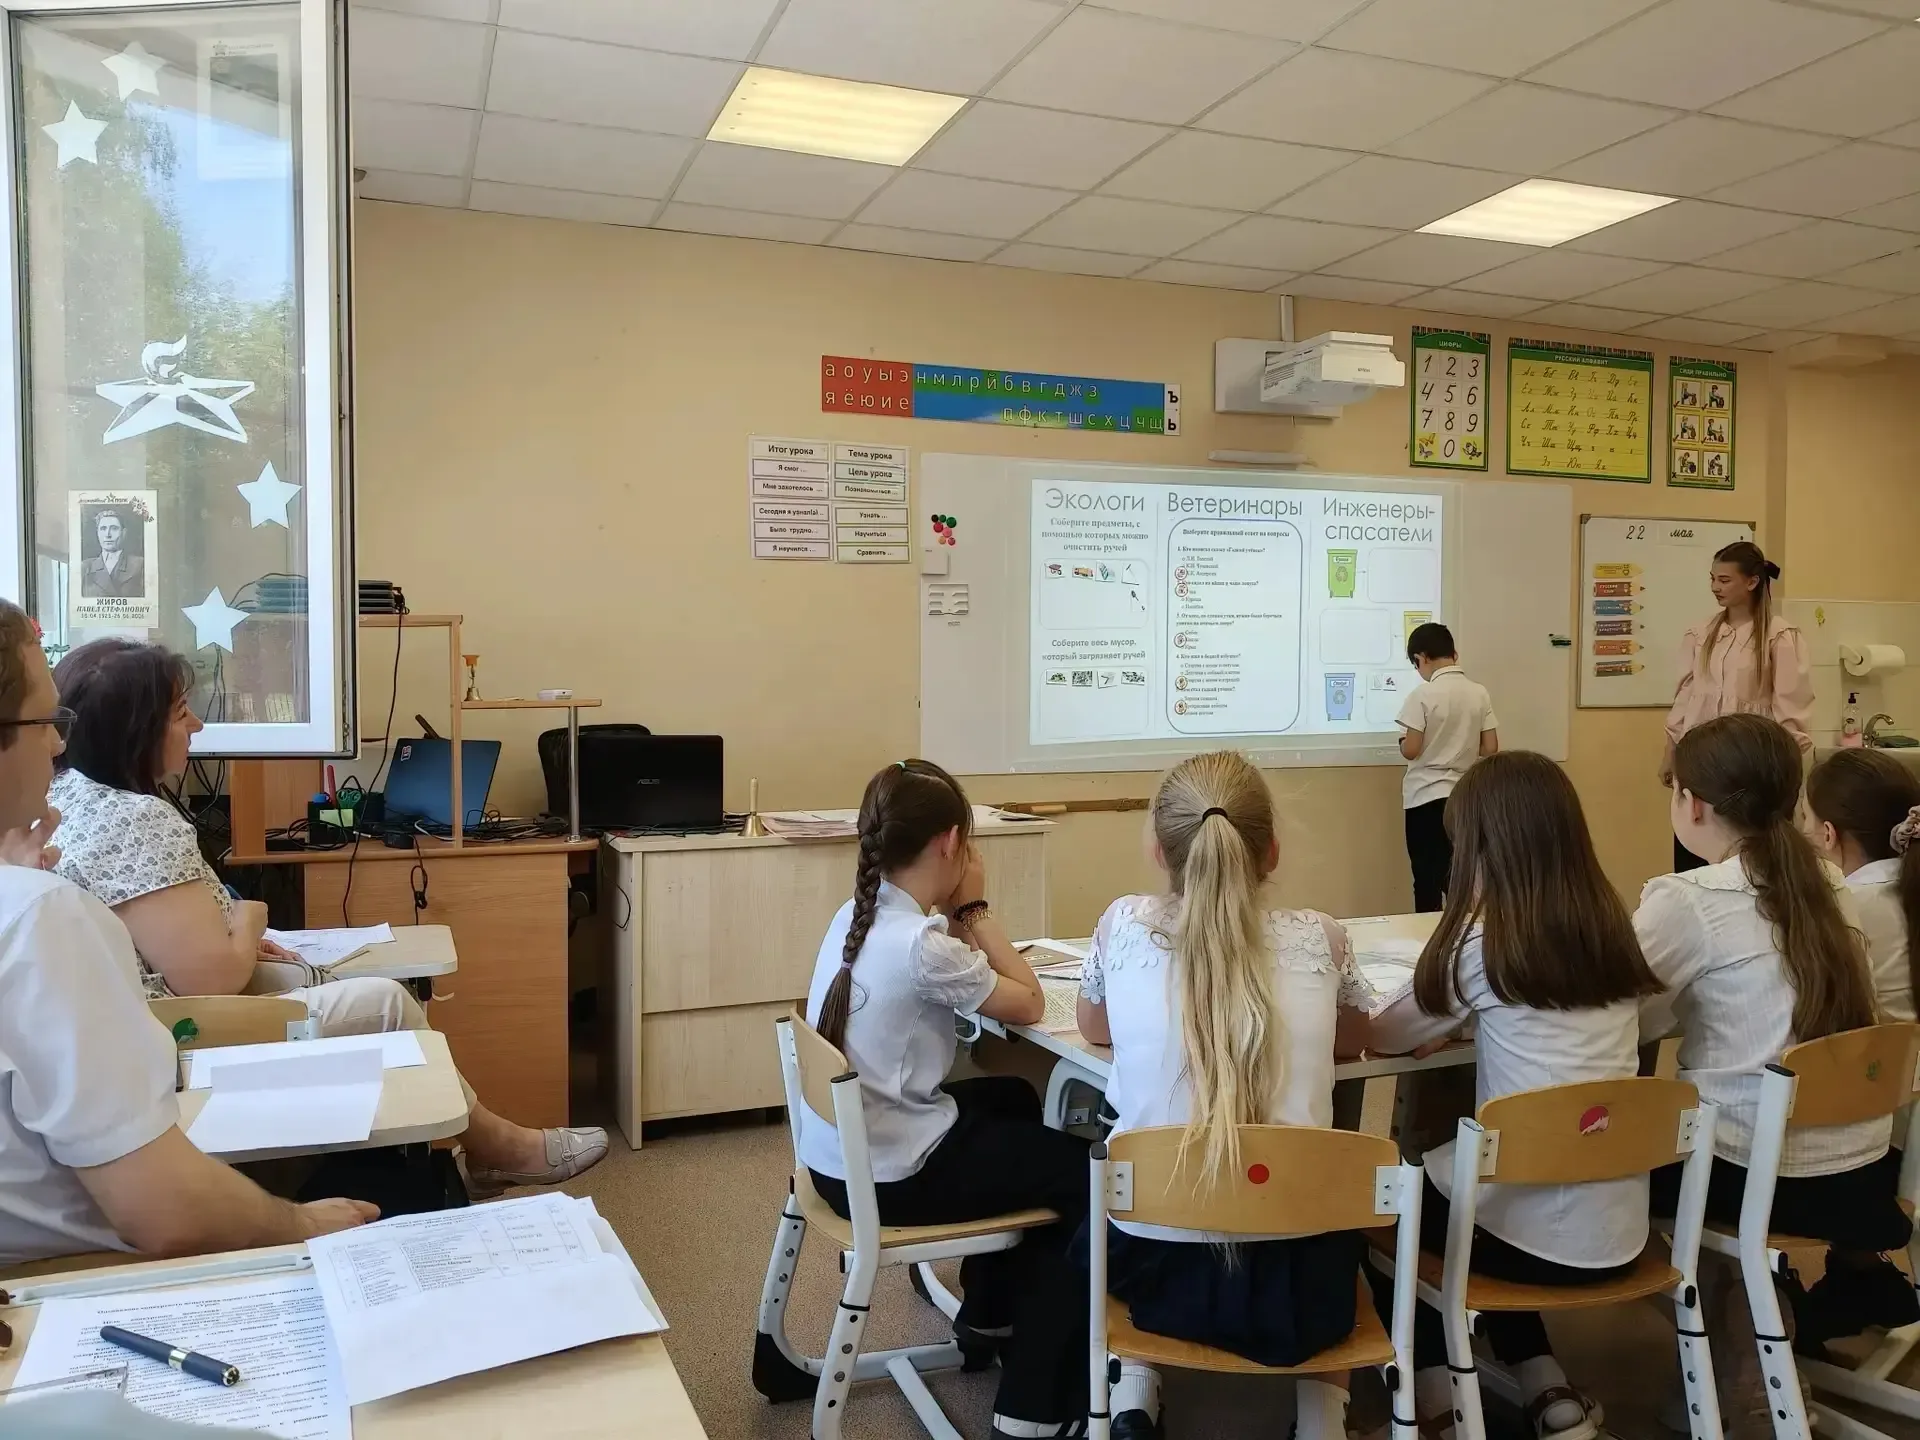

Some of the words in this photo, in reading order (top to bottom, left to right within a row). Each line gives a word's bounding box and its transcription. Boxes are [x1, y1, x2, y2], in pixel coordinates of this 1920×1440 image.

[1554, 354, 1580, 362] РУССКИЙ
[1424, 355, 1432, 373] 1
[1446, 356, 1456, 376] 2
[1467, 359, 1479, 378] 3
[1695, 369, 1727, 378] ПРАВИЛЬНО
[825, 363, 835, 376] а
[844, 365, 854, 378] о
[863, 367, 873, 384] у
[879, 368, 893, 381] ы
[899, 370, 909, 382] э
[917, 371, 926, 384] н
[933, 372, 945, 385] м
[951, 374, 962, 387] л
[969, 375, 979, 392] р
[987, 372, 997, 389] й
[1004, 374, 1014, 391] б
[1022, 381, 1031, 393] в
[1039, 382, 1047, 393] г
[1054, 383, 1065, 397] д
[1069, 384, 1082, 397] ж
[1089, 385, 1097, 397] з
[1421, 382, 1434, 401] 4
[1444, 384, 1457, 403] 5
[1467, 386, 1479, 405] 6
[825, 391, 835, 404] я
[844, 388, 854, 406] ё
[860, 394, 875, 407] ю
[881, 396, 892, 409] и
[899, 397, 909, 410] е
[1003, 408, 1013, 421] п
[1019, 405, 1032, 424] ф
[1038, 410, 1047, 422] к
[1055, 411, 1063, 423] т
[1069, 412, 1083, 425] ш
[1087, 413, 1096, 426] с
[1104, 414, 1113, 426] х
[1120, 416, 1130, 430] ц
[1136, 416, 1145, 428] ч
[1150, 417, 1164, 431] щ
[1422, 409, 1433, 428] 7
[1445, 411, 1455, 431] 8
[1466, 413, 1478, 432] 9
[768, 445, 788, 454] Итог
[789, 447, 814, 456] урока
[1443, 439, 1455, 458] 0
[848, 449, 868, 458] Тема
[870, 452, 893, 460] урока
[848, 468, 869, 477] Цель
[870, 470, 893, 478] урока
[778, 484, 814, 492] захотелось
[1045, 487, 1144, 512] Экологи
[1167, 492, 1302, 519] Ветеринары
[1323, 496, 1435, 523] Инженеры-
[759, 507, 786, 516] Сегодня
[1050, 517, 1090, 528] Соберите
[1091, 519, 1135, 529] предметы,
[1041, 531, 1083, 540] помощью
[1084, 532, 1120, 541] которых
[1121, 533, 1149, 541] можно
[1325, 524, 1433, 542] спасатели
[1669, 527, 1694, 538] мая
[1063, 543, 1102, 551] очистить
[1103, 543, 1128, 553] ручей
[97, 598, 128, 606] ЖИРОВ
[1051, 639, 1089, 648] Соберите
[1042, 652, 1077, 661] который
[1078, 652, 1121, 661] загрязняет
[1122, 651, 1146, 660] ручей
